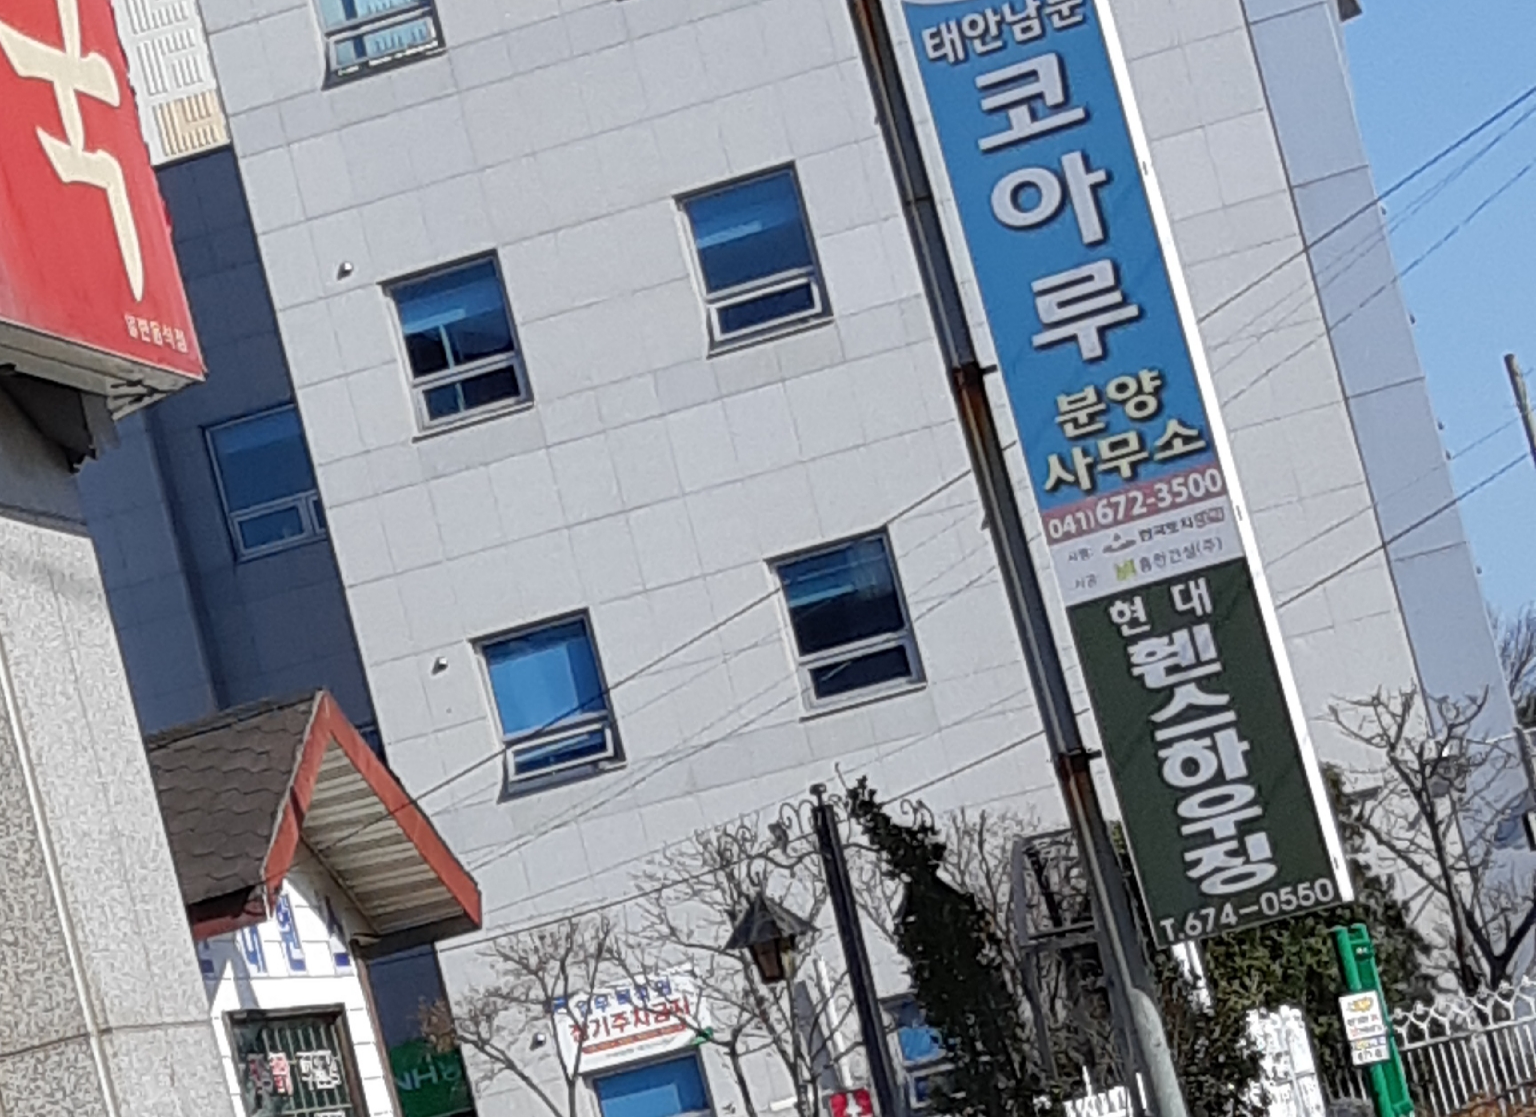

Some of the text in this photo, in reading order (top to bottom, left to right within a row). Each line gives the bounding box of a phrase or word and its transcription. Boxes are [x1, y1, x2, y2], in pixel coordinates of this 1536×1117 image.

[974, 51, 1139, 361] 코아루
[1055, 369, 1163, 436] 분양
[1044, 417, 1207, 495] 사무소
[1159, 878, 1334, 943] T.674-0550
